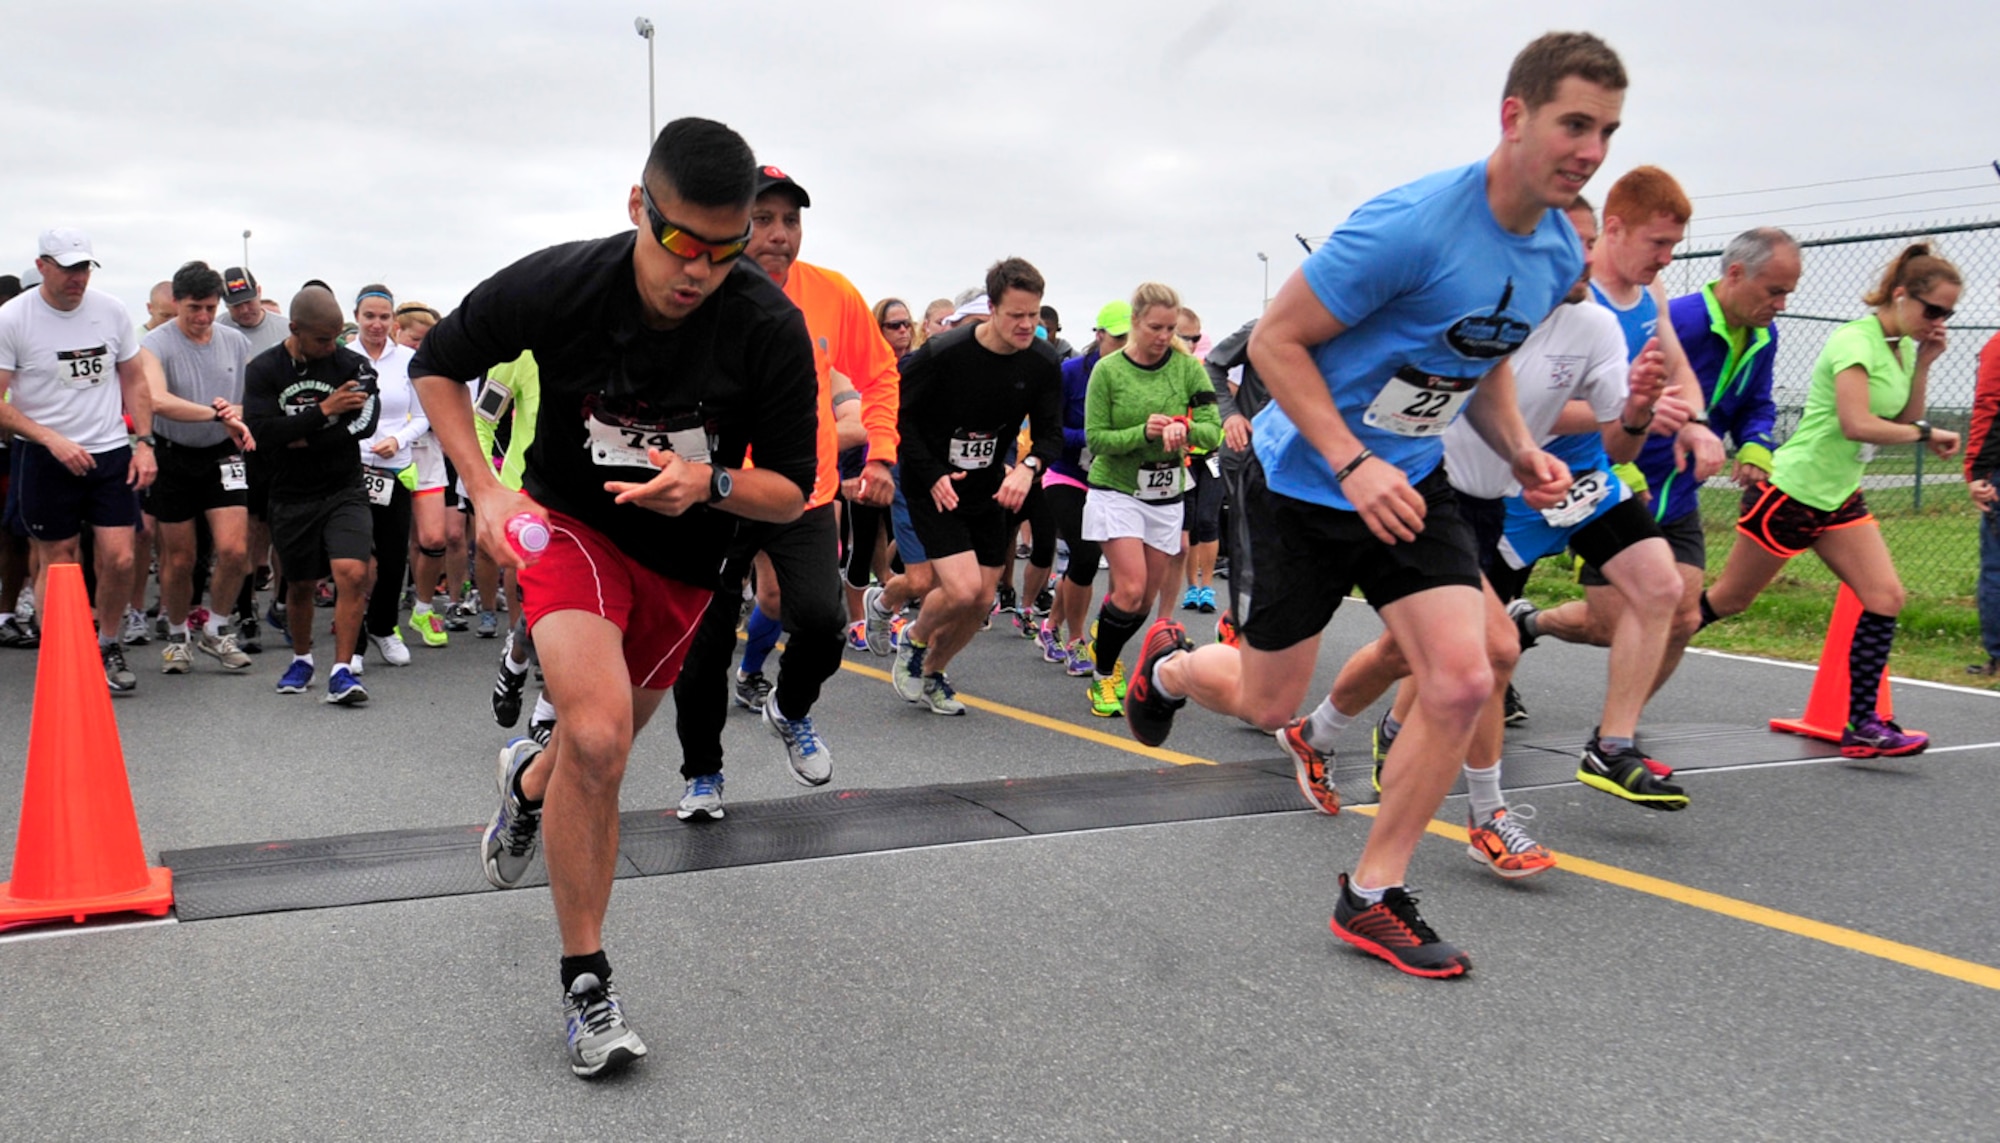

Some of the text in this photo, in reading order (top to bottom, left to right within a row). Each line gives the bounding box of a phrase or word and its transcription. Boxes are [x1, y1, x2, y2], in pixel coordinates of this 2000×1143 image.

[69, 356, 103, 378] 136
[1401, 390, 1451, 418] 22
[620, 428, 675, 452] 74
[960, 441, 995, 458] 148
[1147, 470, 1174, 488] 129
